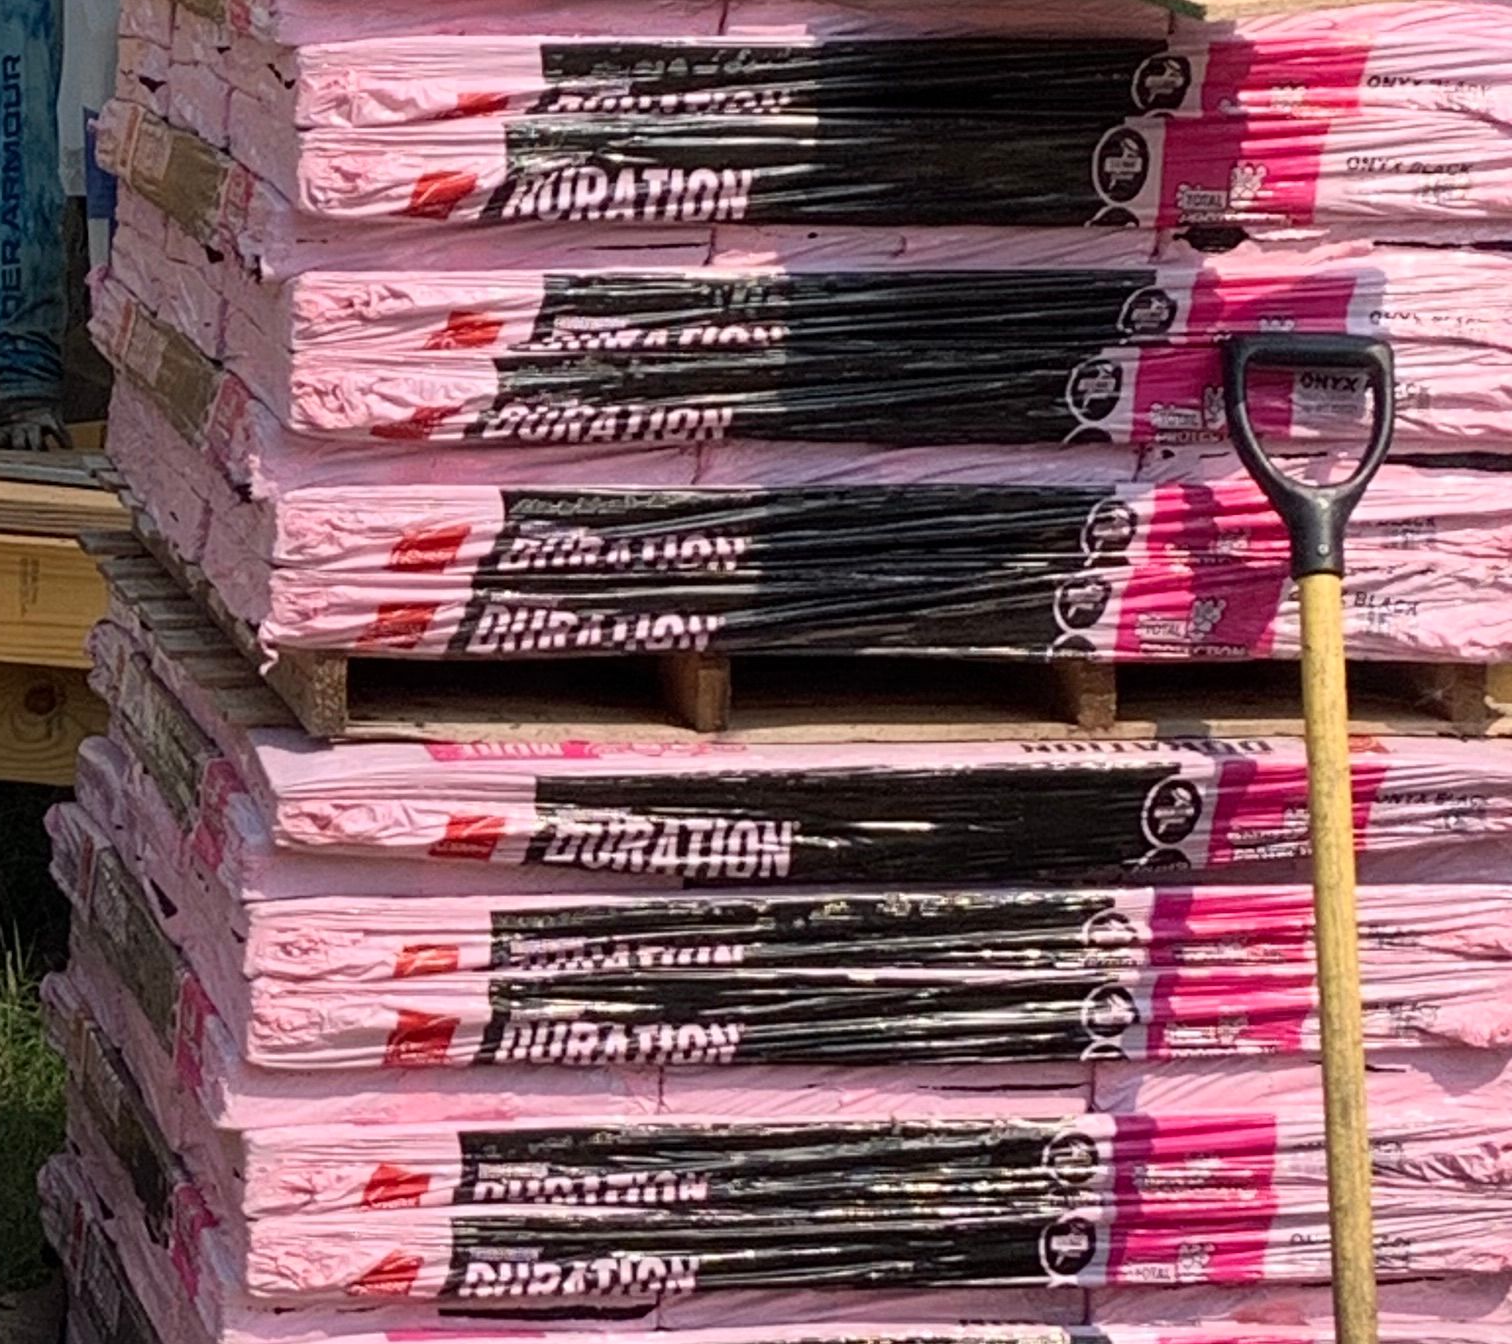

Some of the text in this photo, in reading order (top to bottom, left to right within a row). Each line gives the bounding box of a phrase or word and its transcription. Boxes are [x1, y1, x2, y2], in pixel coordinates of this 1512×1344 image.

[1, 54, 23, 322] DER ARMOUR
[500, 165, 755, 222] DURATION
[1299, 372, 1361, 394] ONYX
[1353, 592, 1420, 616] BLACK
[544, 816, 792, 878] DURATION
